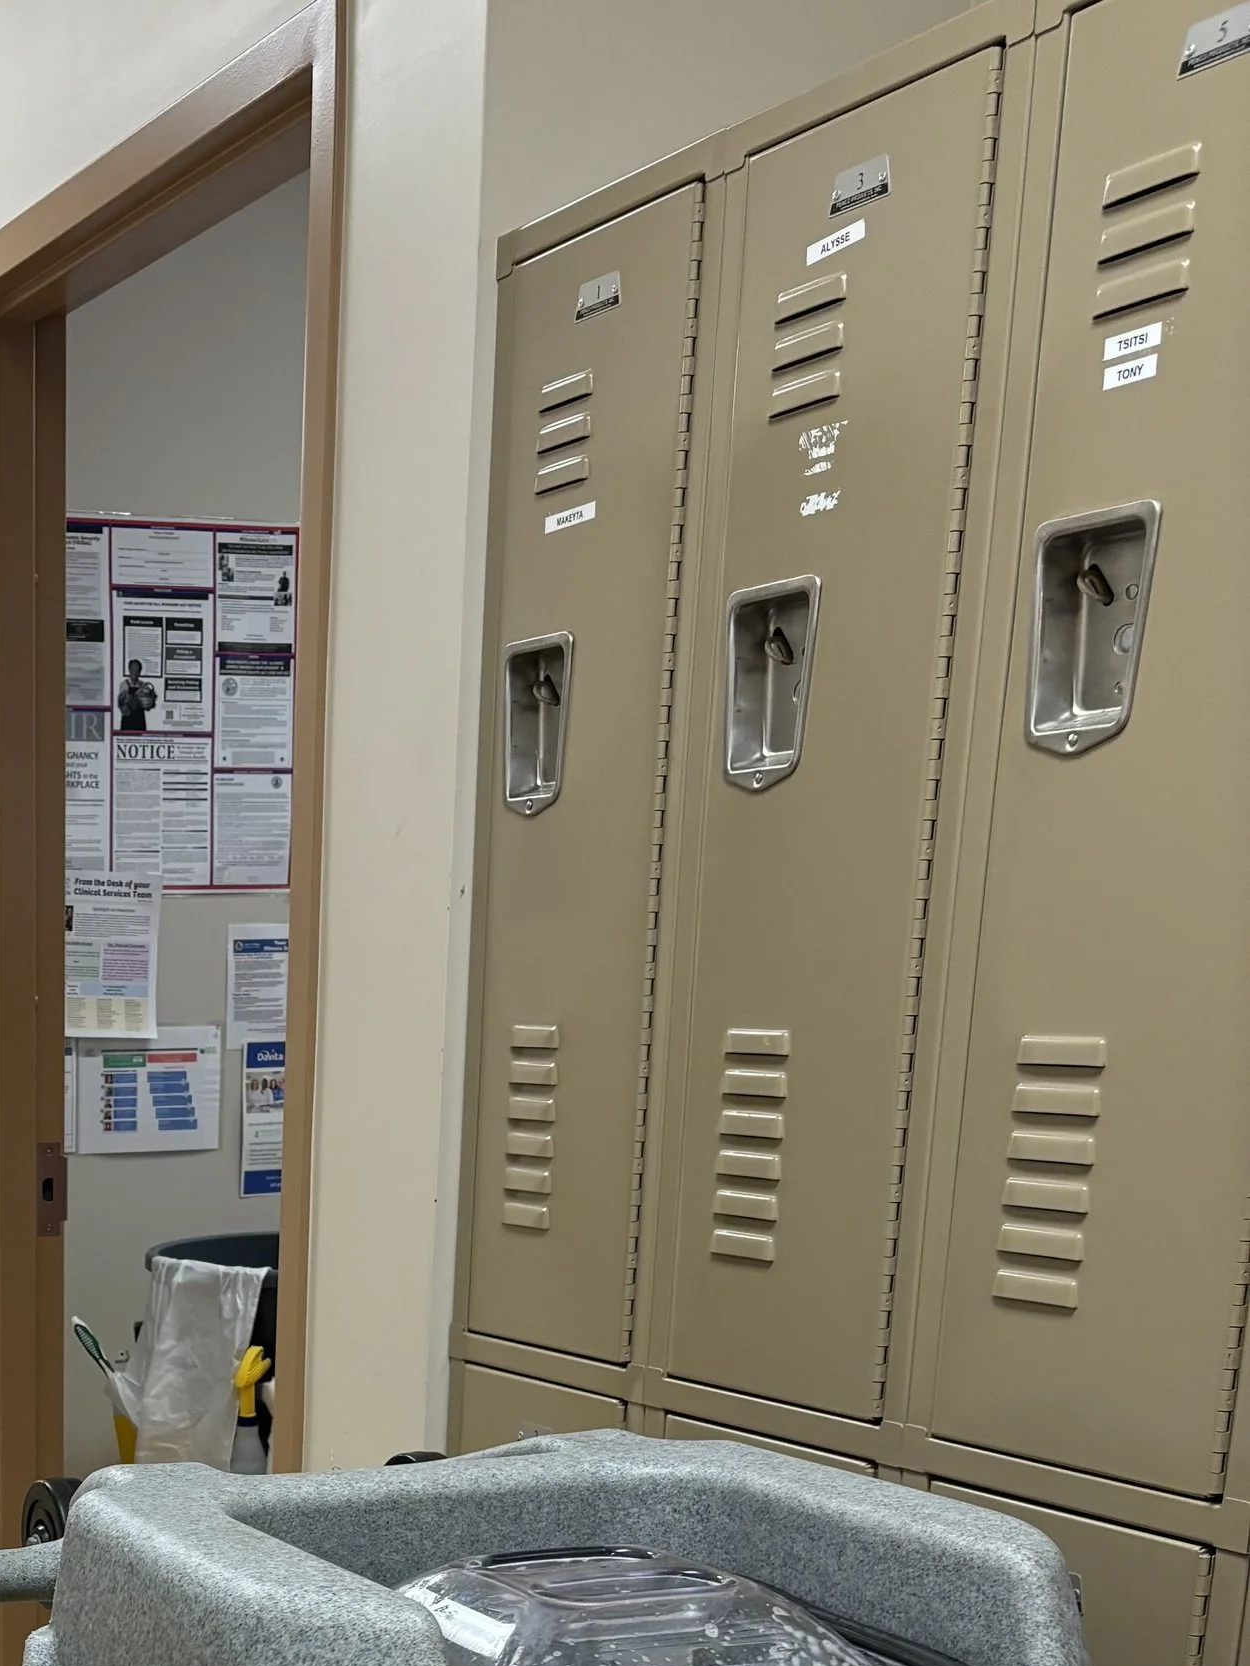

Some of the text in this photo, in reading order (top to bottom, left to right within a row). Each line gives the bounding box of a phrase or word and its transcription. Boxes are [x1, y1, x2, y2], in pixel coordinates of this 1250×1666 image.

[1217, 20, 1228, 43] 5
[857, 172, 864, 190] 3
[821, 231, 850, 255] ALYSSE
[1117, 333, 1148, 351] TSITSI
[1116, 363, 1144, 381] TONY
[116, 744, 175, 760] NOTICE
[74, 878, 93, 886] From
[93, 878, 105, 887] the
[106, 879, 123, 887] Desk
[124, 880, 133, 889] of
[74, 887, 152, 899] Clinical Services Team
